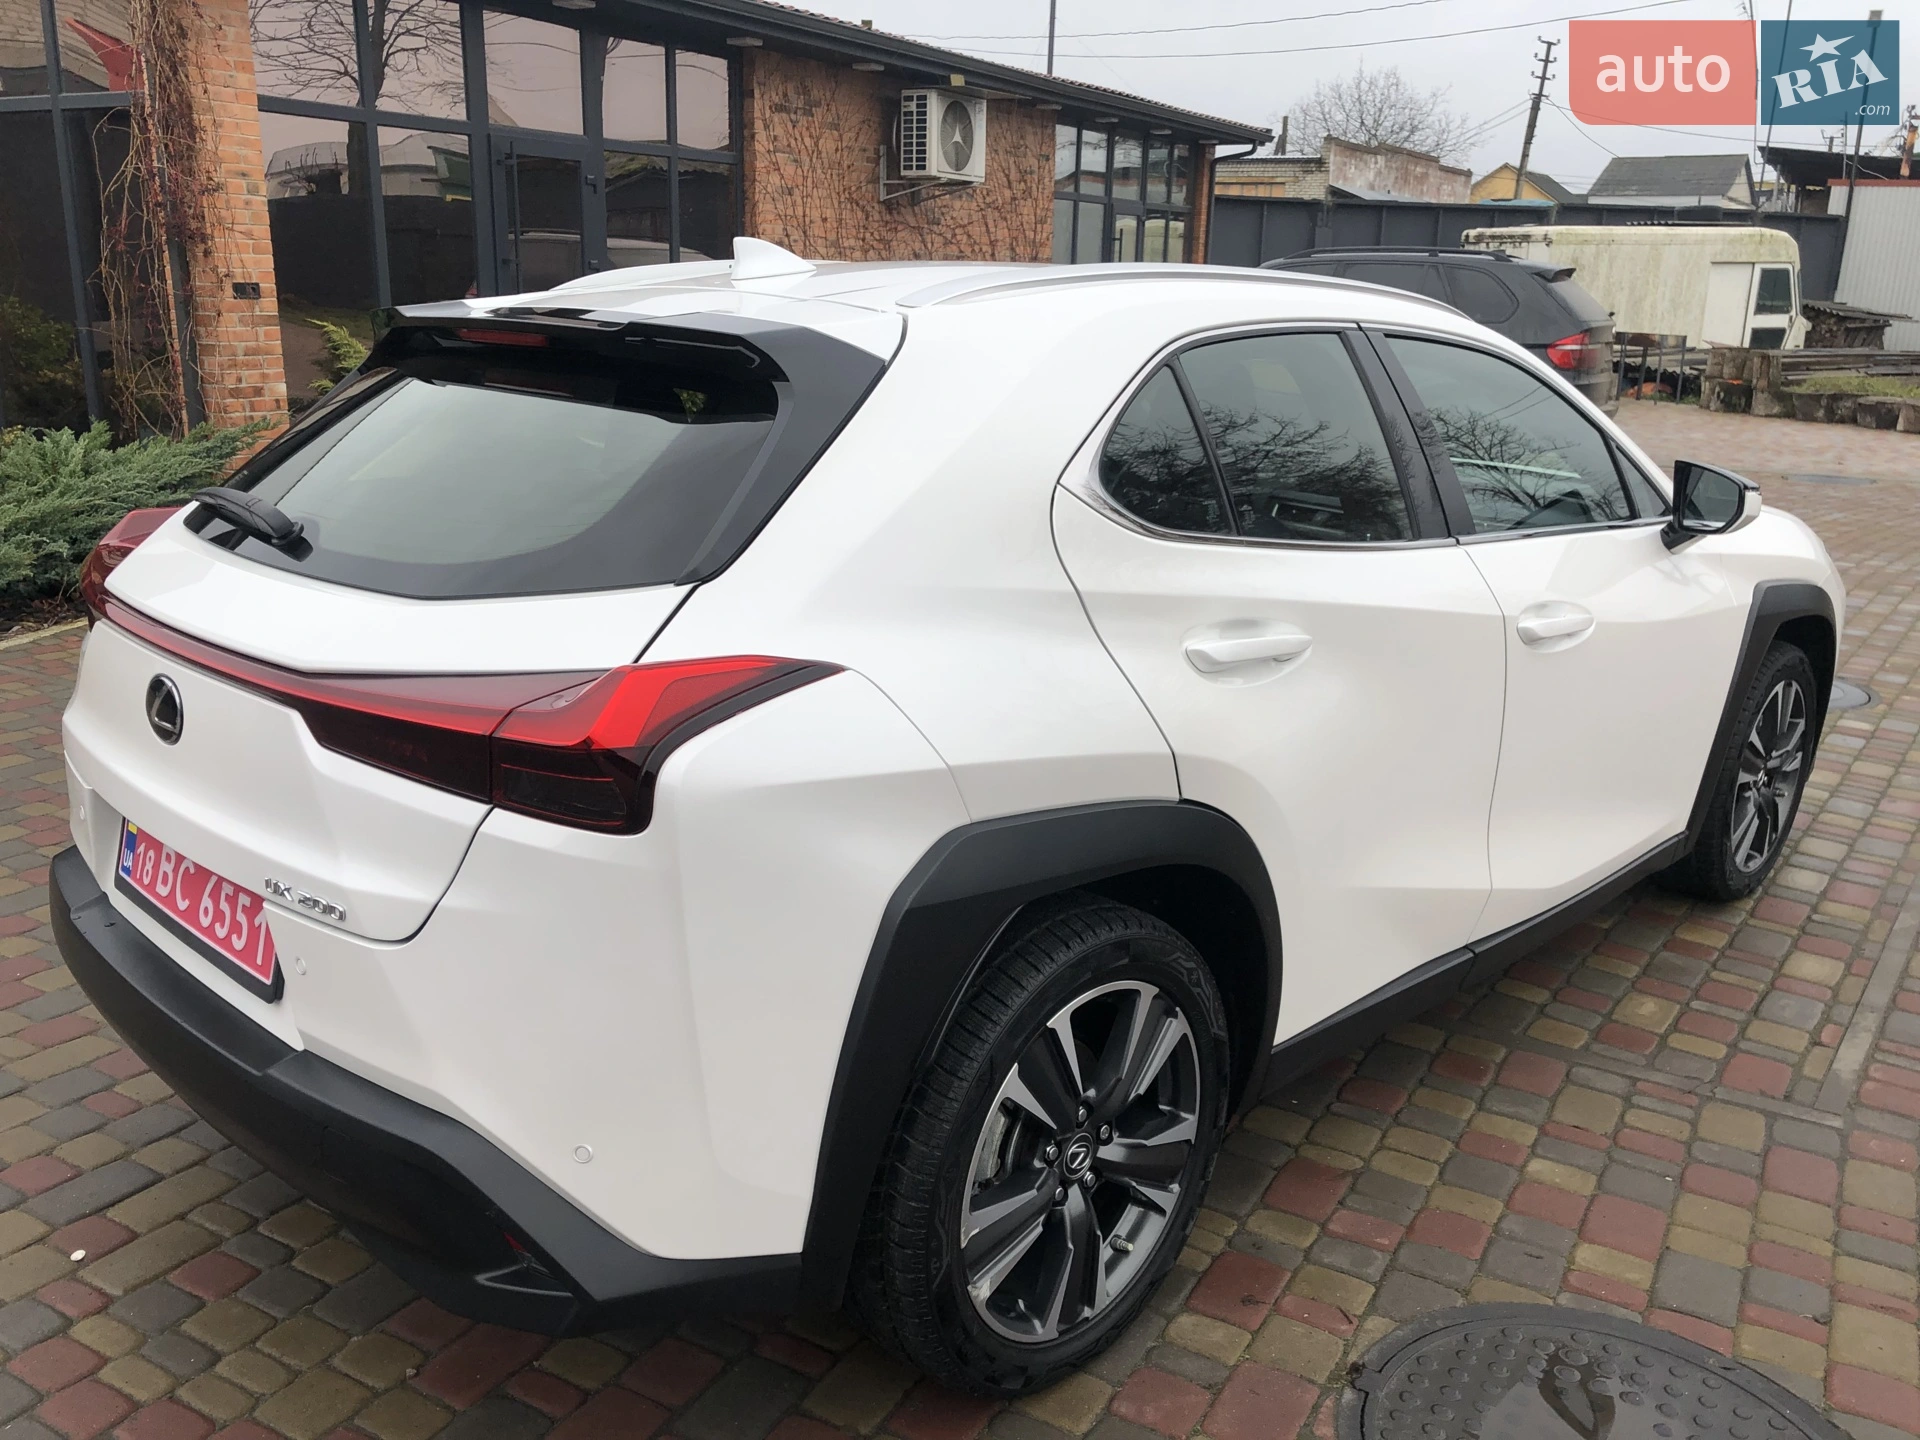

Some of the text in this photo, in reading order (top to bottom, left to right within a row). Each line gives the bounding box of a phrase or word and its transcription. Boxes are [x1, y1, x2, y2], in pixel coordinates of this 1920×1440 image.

[123, 847, 134, 870] UA
[136, 842, 268, 966] 18 BC 6551
[264, 877, 346, 921] UX 200
